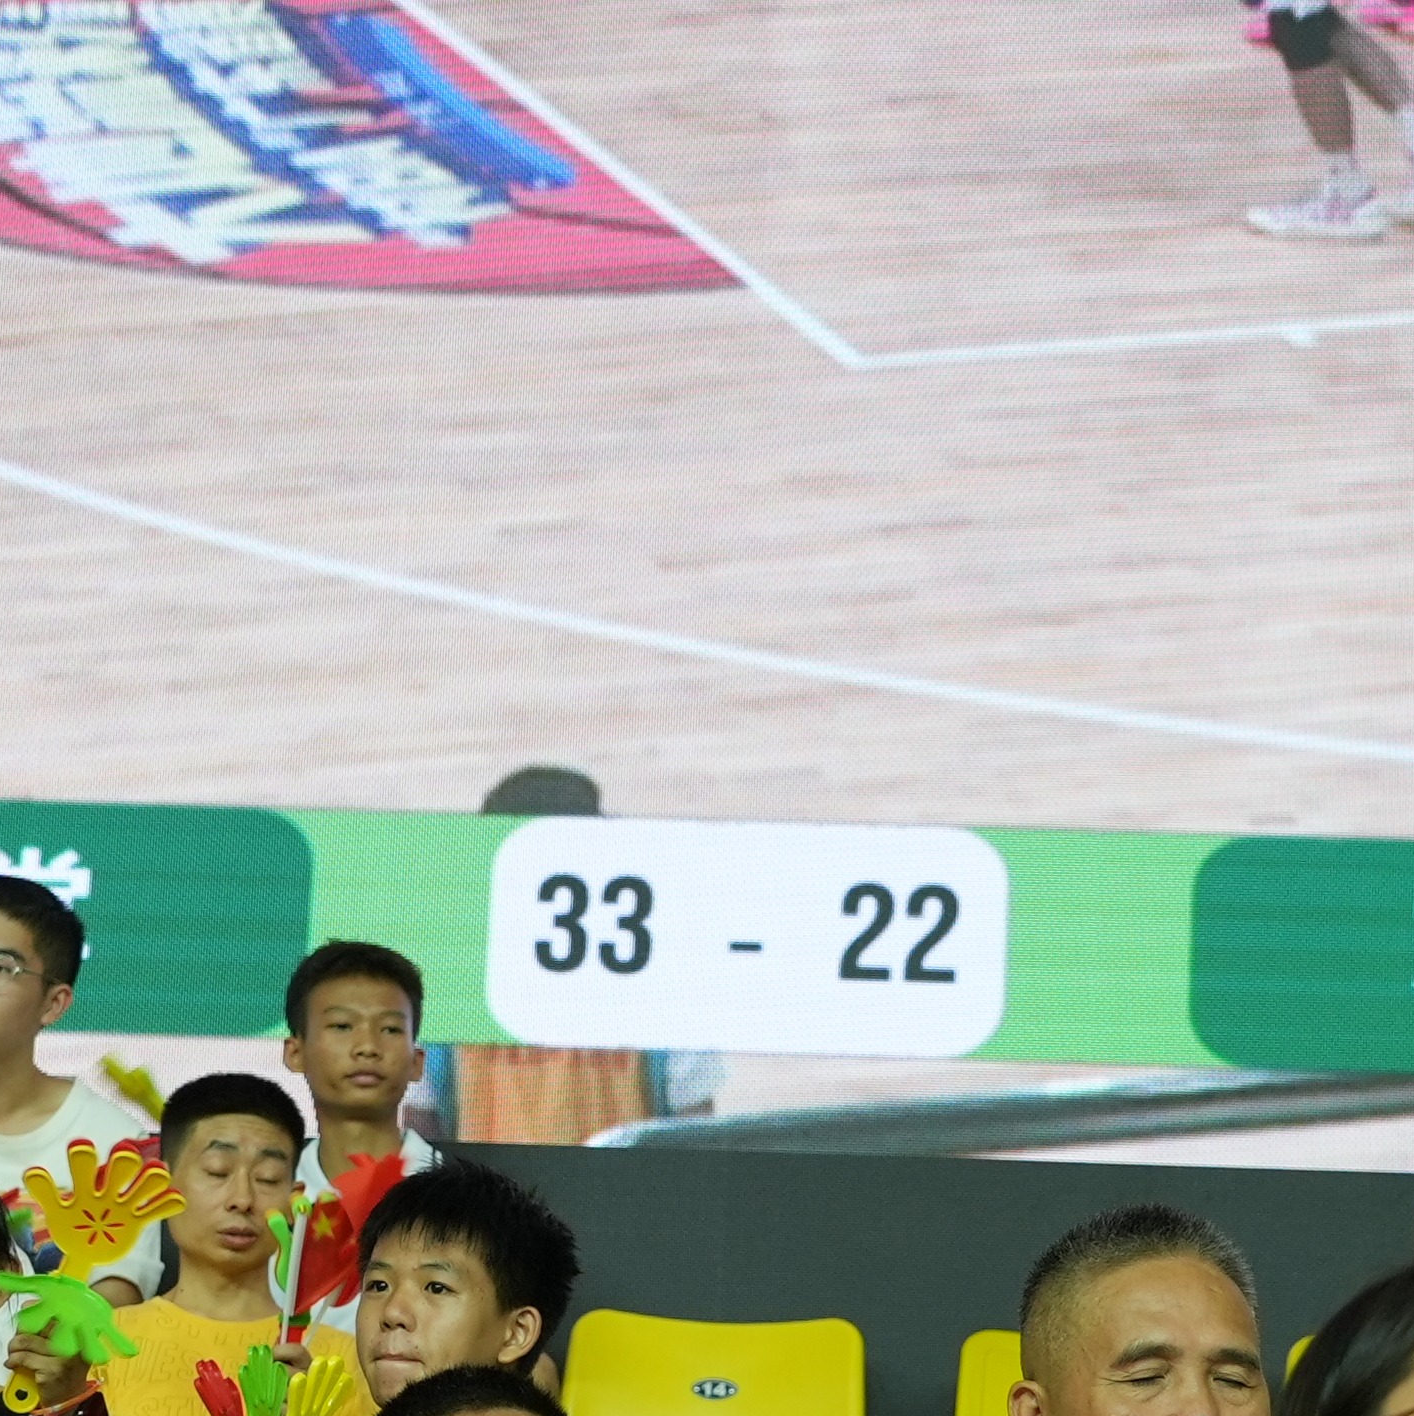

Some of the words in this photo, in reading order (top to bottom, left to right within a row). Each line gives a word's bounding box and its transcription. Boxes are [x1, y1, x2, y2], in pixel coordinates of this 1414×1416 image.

[535, 873, 654, 974] 33
[838, 882, 959, 982] 22
[700, 1380, 727, 1398] 14
